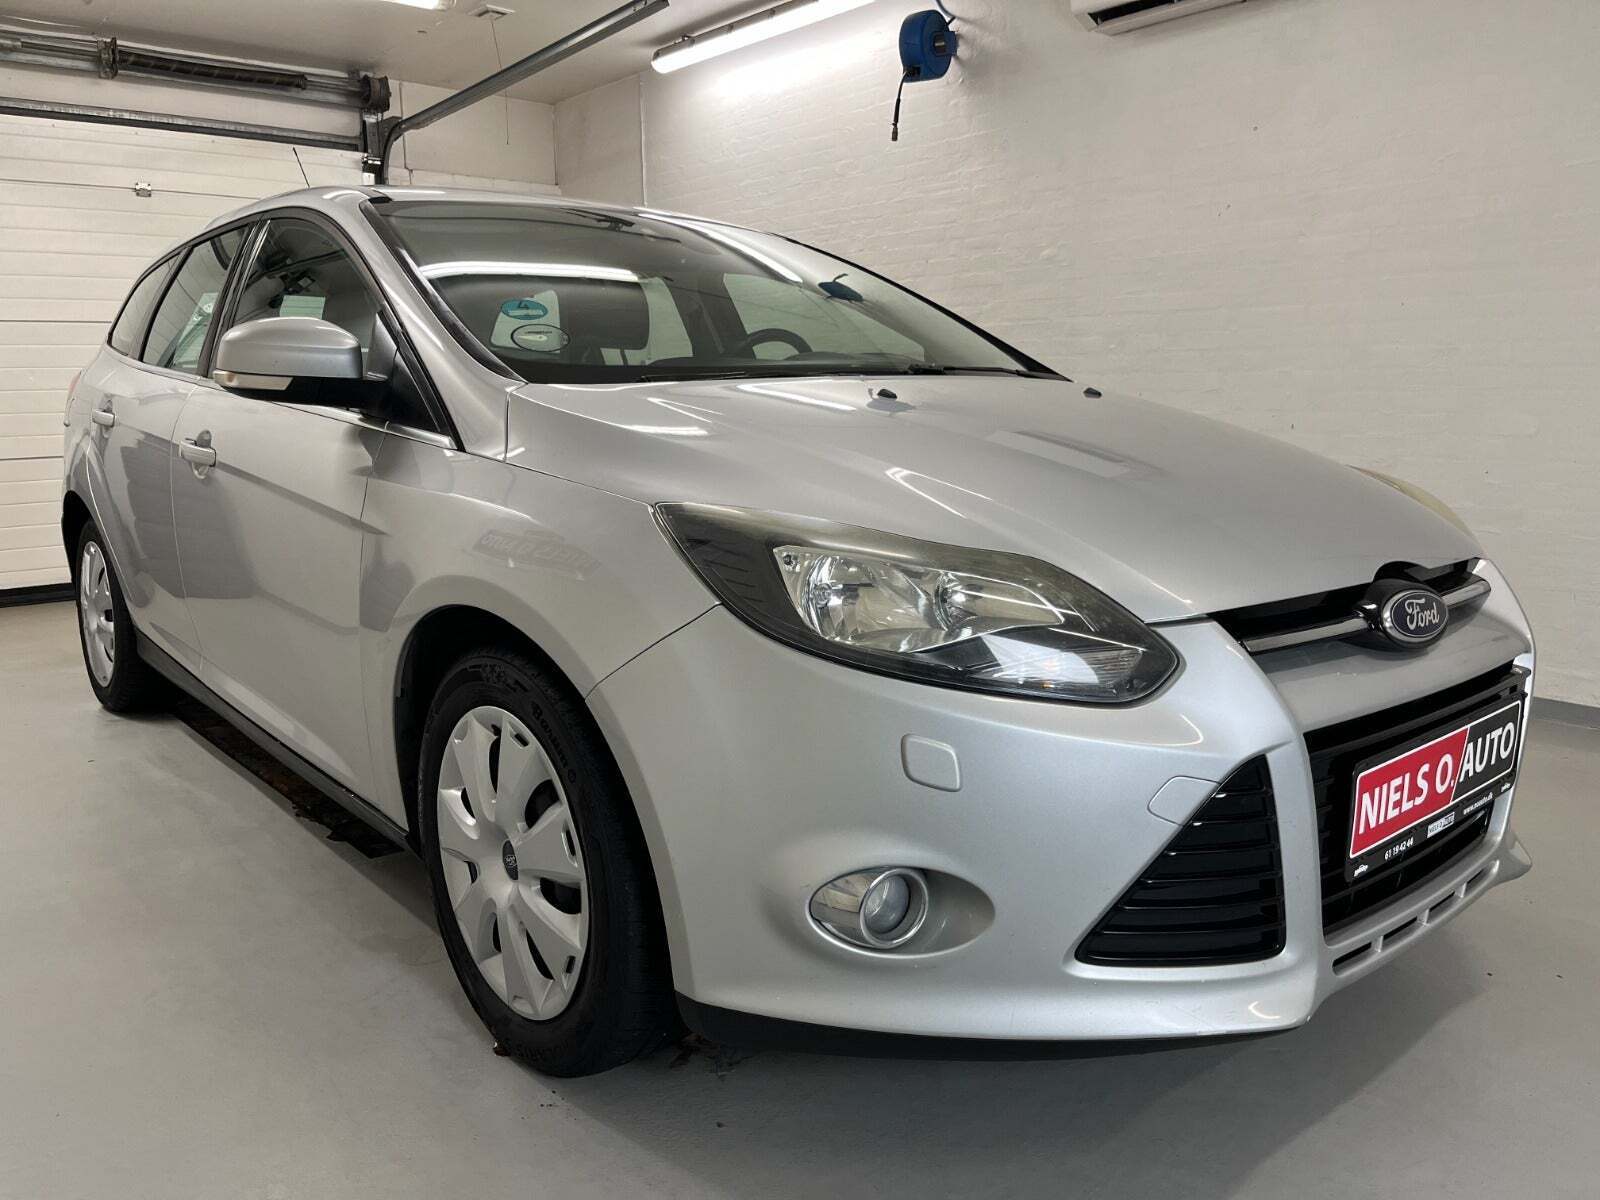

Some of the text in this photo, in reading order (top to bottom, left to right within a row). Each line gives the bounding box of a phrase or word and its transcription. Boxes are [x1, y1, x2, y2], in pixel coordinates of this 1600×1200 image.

[1404, 597, 1440, 630] Ford
[1359, 722, 1515, 835] NIELS O. AUTO
